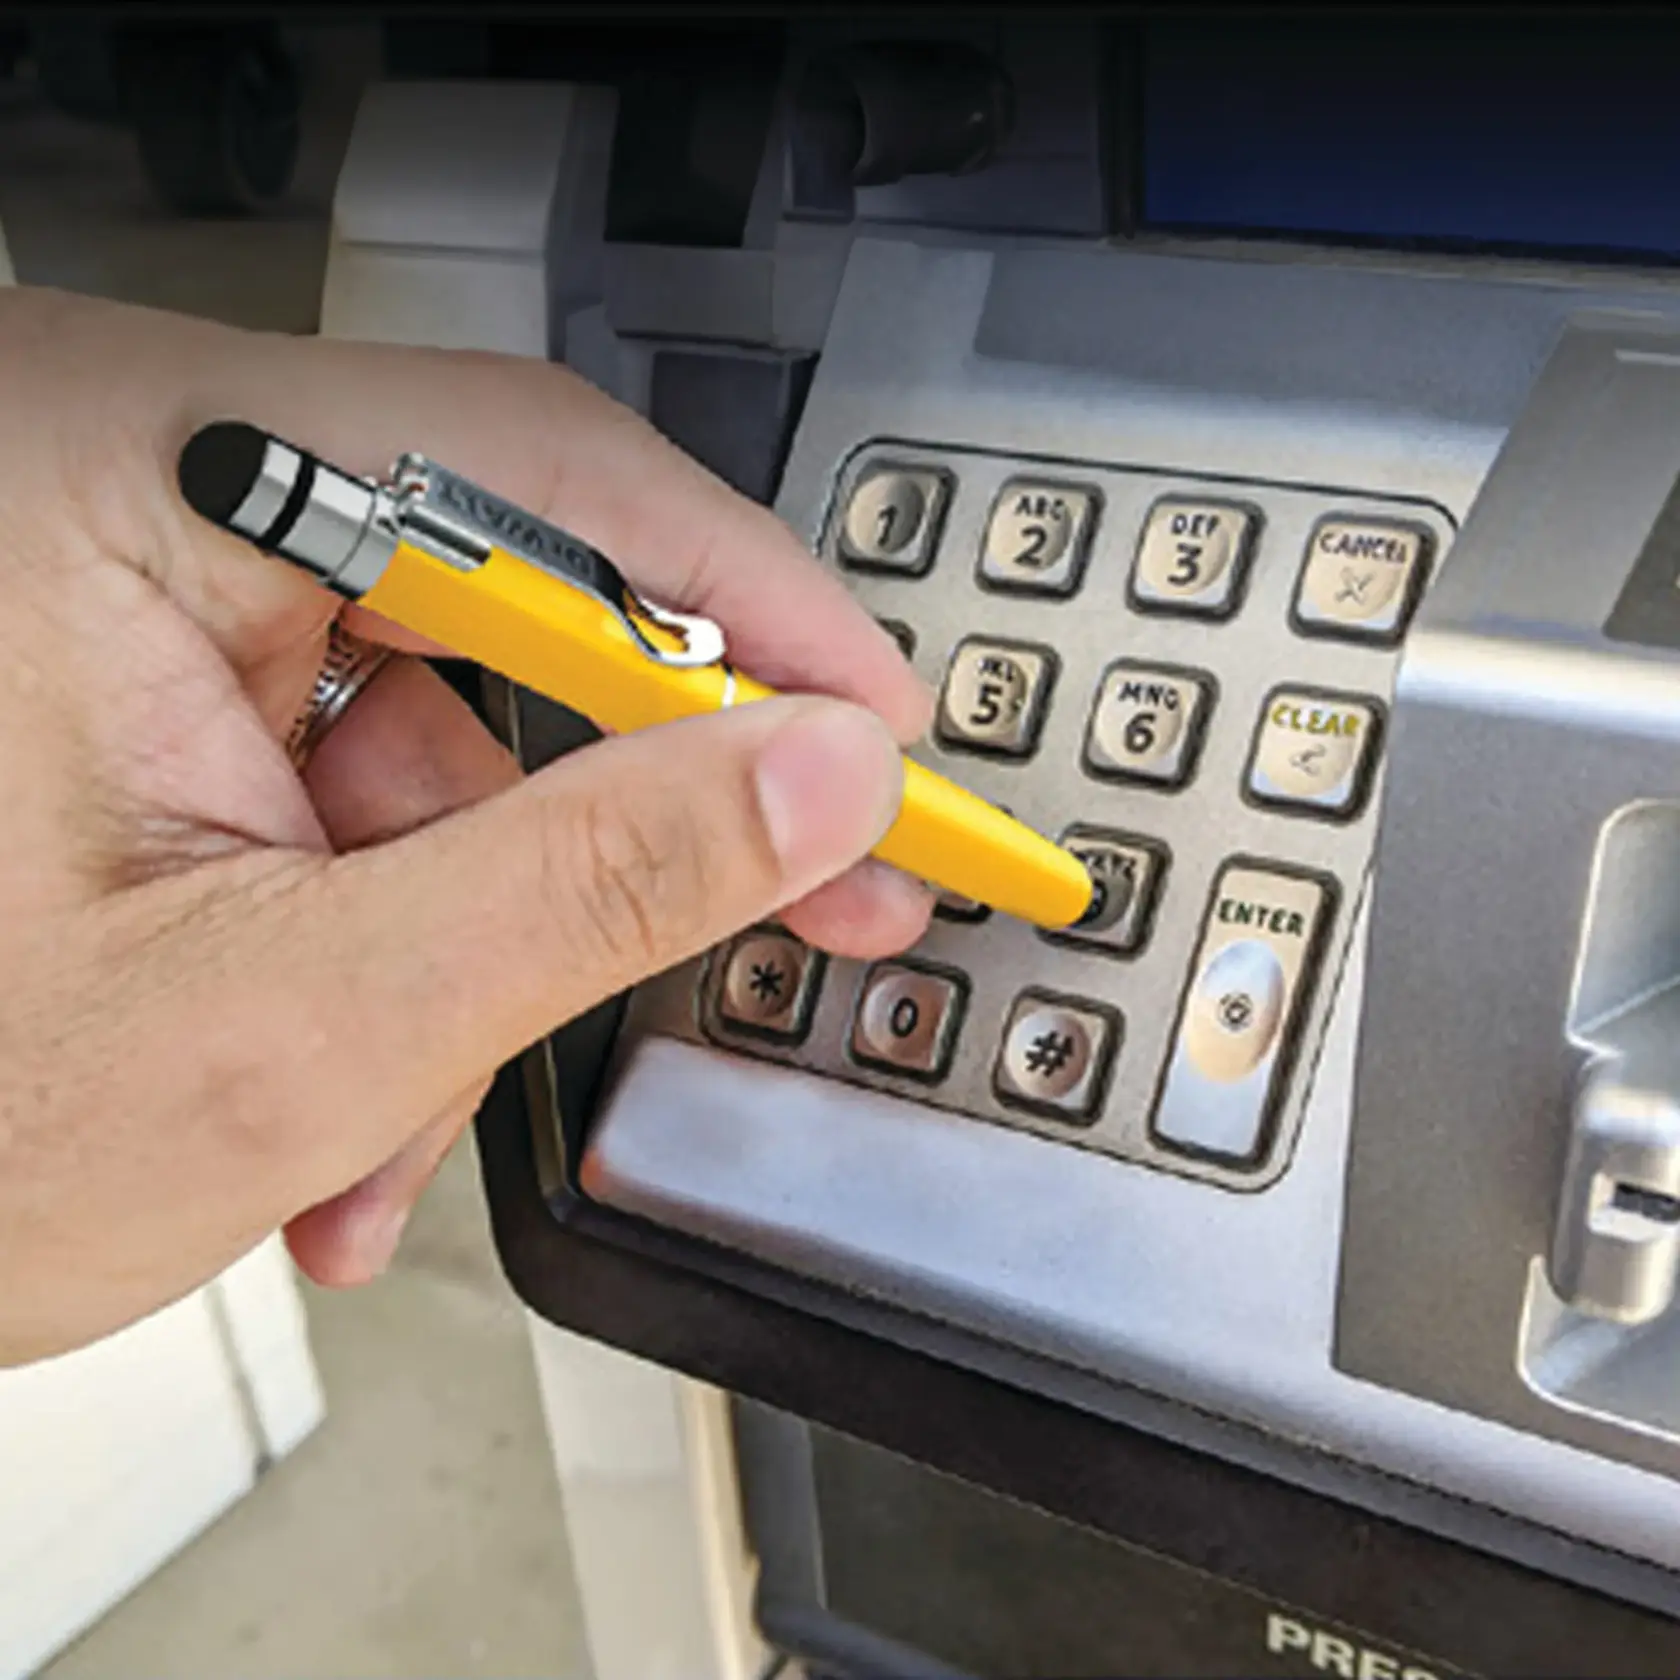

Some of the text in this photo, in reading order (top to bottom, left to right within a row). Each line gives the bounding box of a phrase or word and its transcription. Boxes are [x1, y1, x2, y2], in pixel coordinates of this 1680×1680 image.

[878, 504, 899, 547] 1
[1014, 494, 1066, 521] ABC
[1170, 513, 1220, 538] DEF
[1013, 525, 1048, 567] 2
[1167, 542, 1203, 587] 3
[1318, 531, 1408, 564] CANCEL
[969, 683, 1004, 726] 5
[1117, 682, 1180, 711] MNO
[1124, 712, 1156, 755] 6
[1271, 703, 1361, 738] CLEAR
[1217, 898, 1305, 937] ENTER
[1023, 1029, 1076, 1078] #
